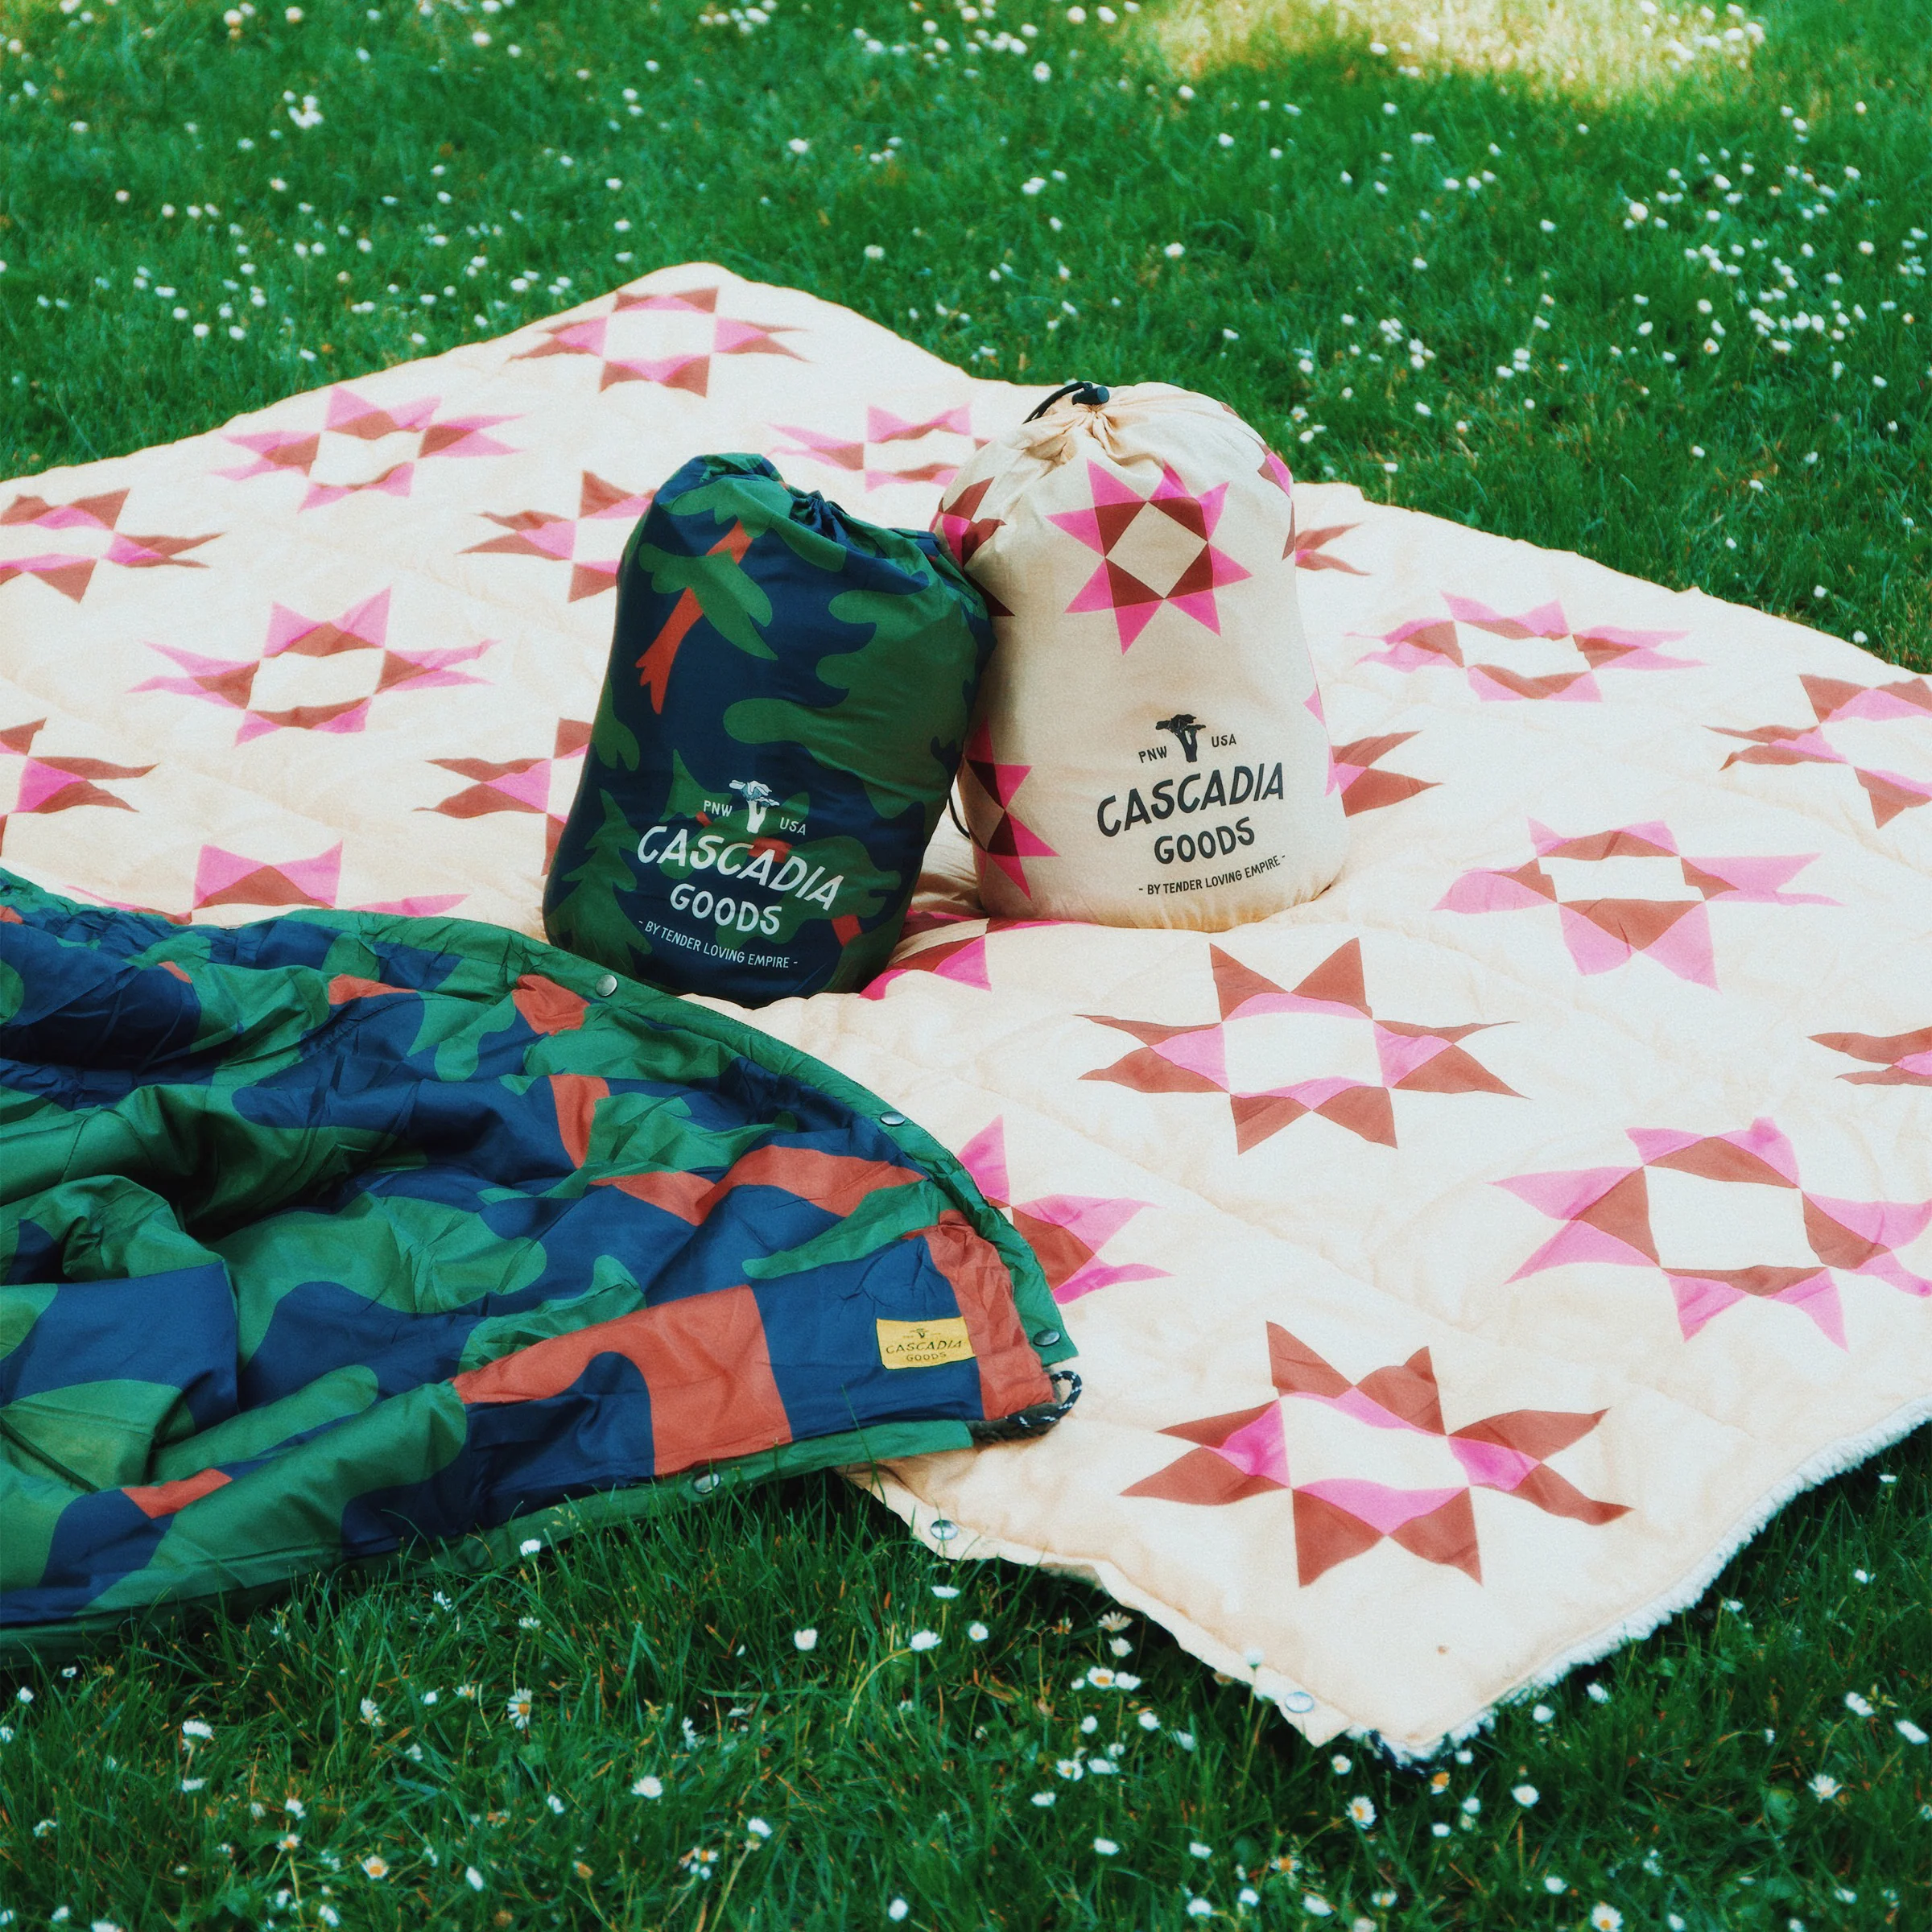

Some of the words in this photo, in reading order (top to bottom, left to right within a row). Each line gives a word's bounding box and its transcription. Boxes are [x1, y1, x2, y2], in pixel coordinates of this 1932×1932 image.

[1138, 746, 1167, 763] PNW
[1212, 733, 1236, 748] USA
[704, 800, 733, 817] PNW
[1097, 762, 1284, 837] CASCADIA
[779, 817, 806, 836] USA
[1154, 816, 1255, 865] GOODS
[638, 826, 844, 911] CASCADIA
[1147, 884, 1162, 895] BY
[1163, 879, 1203, 894] TENDER
[1205, 870, 1242, 888] LOVING
[1245, 855, 1281, 878] EMPIRE
[670, 883, 782, 935] GOODS
[645, 920, 661, 935] BY
[661, 927, 702, 952] TENDER
[704, 943, 745, 964] LOVING
[748, 954, 790, 968] EMPIRE
[886, 1340, 962, 1354] CASCADIA
[906, 1352, 947, 1362] GOODS
